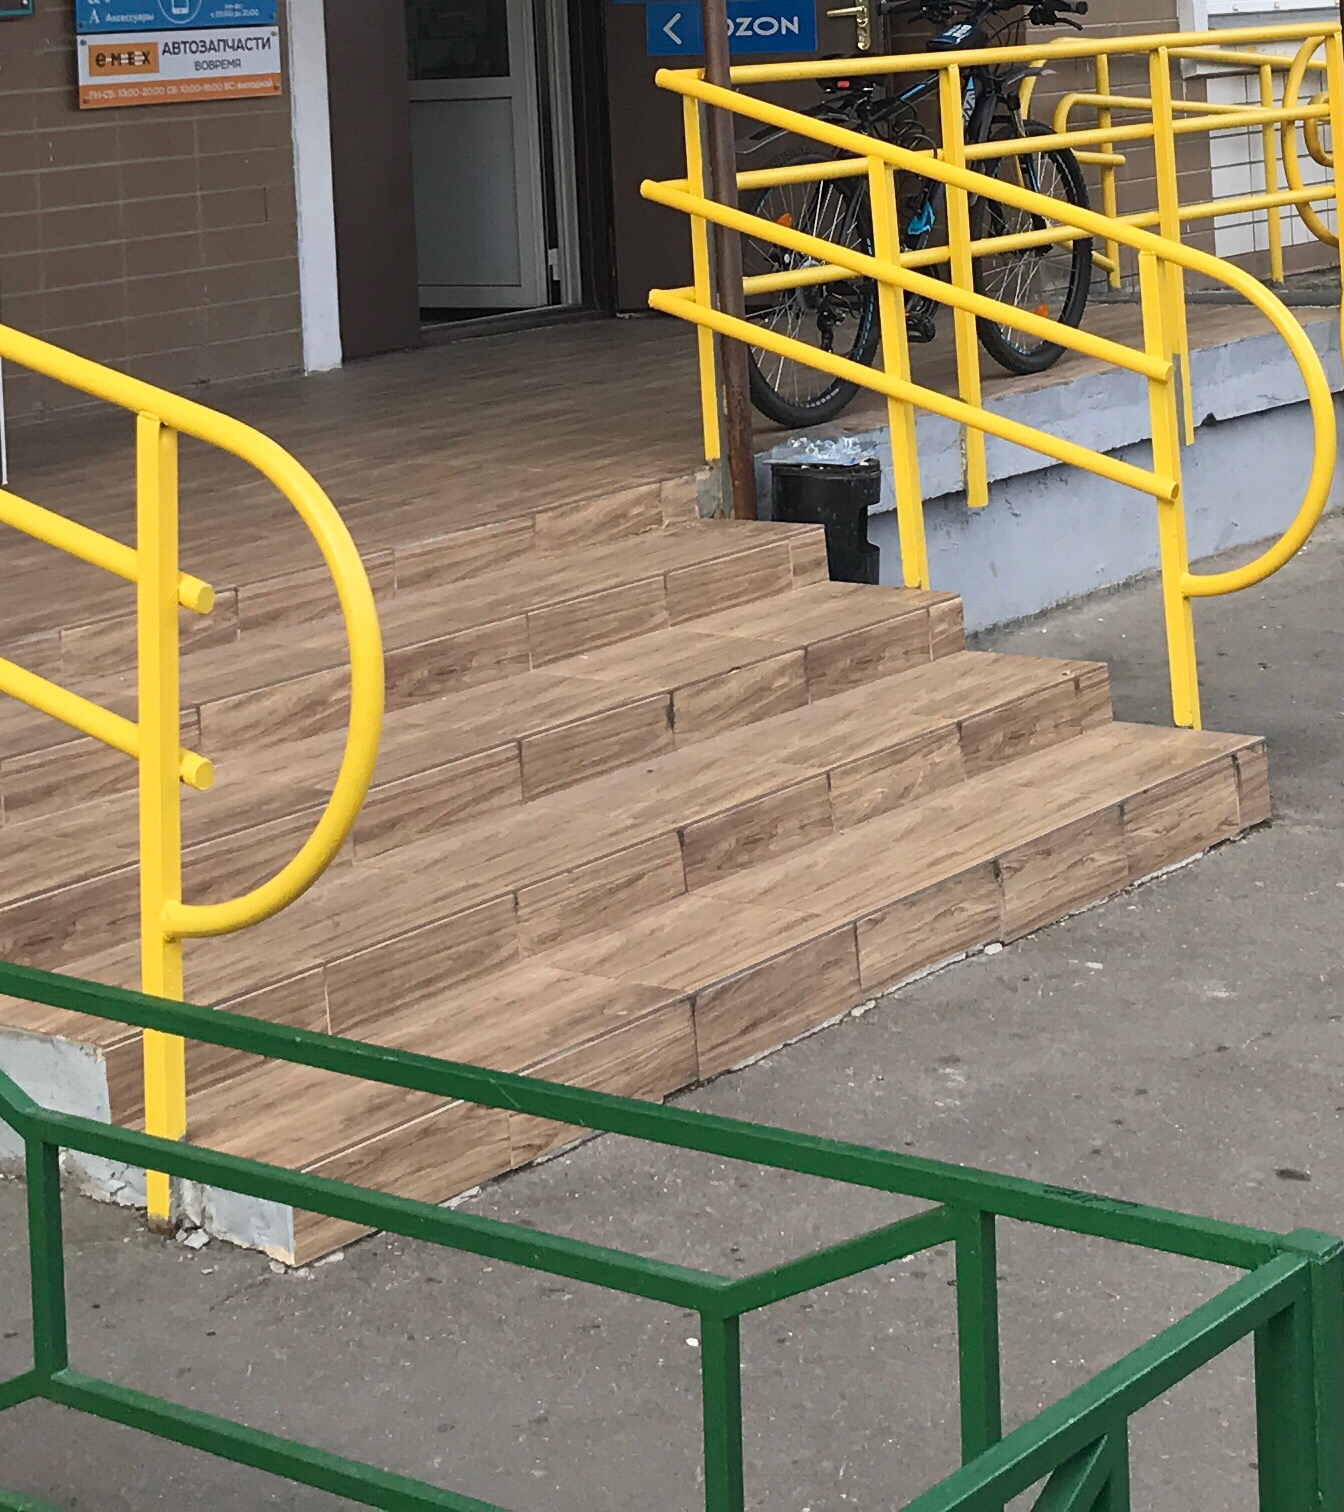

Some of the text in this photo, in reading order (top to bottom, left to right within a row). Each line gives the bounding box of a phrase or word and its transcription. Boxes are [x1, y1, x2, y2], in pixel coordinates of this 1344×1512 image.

[105, 12, 155, 24] Аксессуары
[727, 15, 799, 37] ZON
[162, 37, 272, 56] АВТОЗАПЧАСТИ
[194, 59, 242, 71] ВОВРЕМЯ
